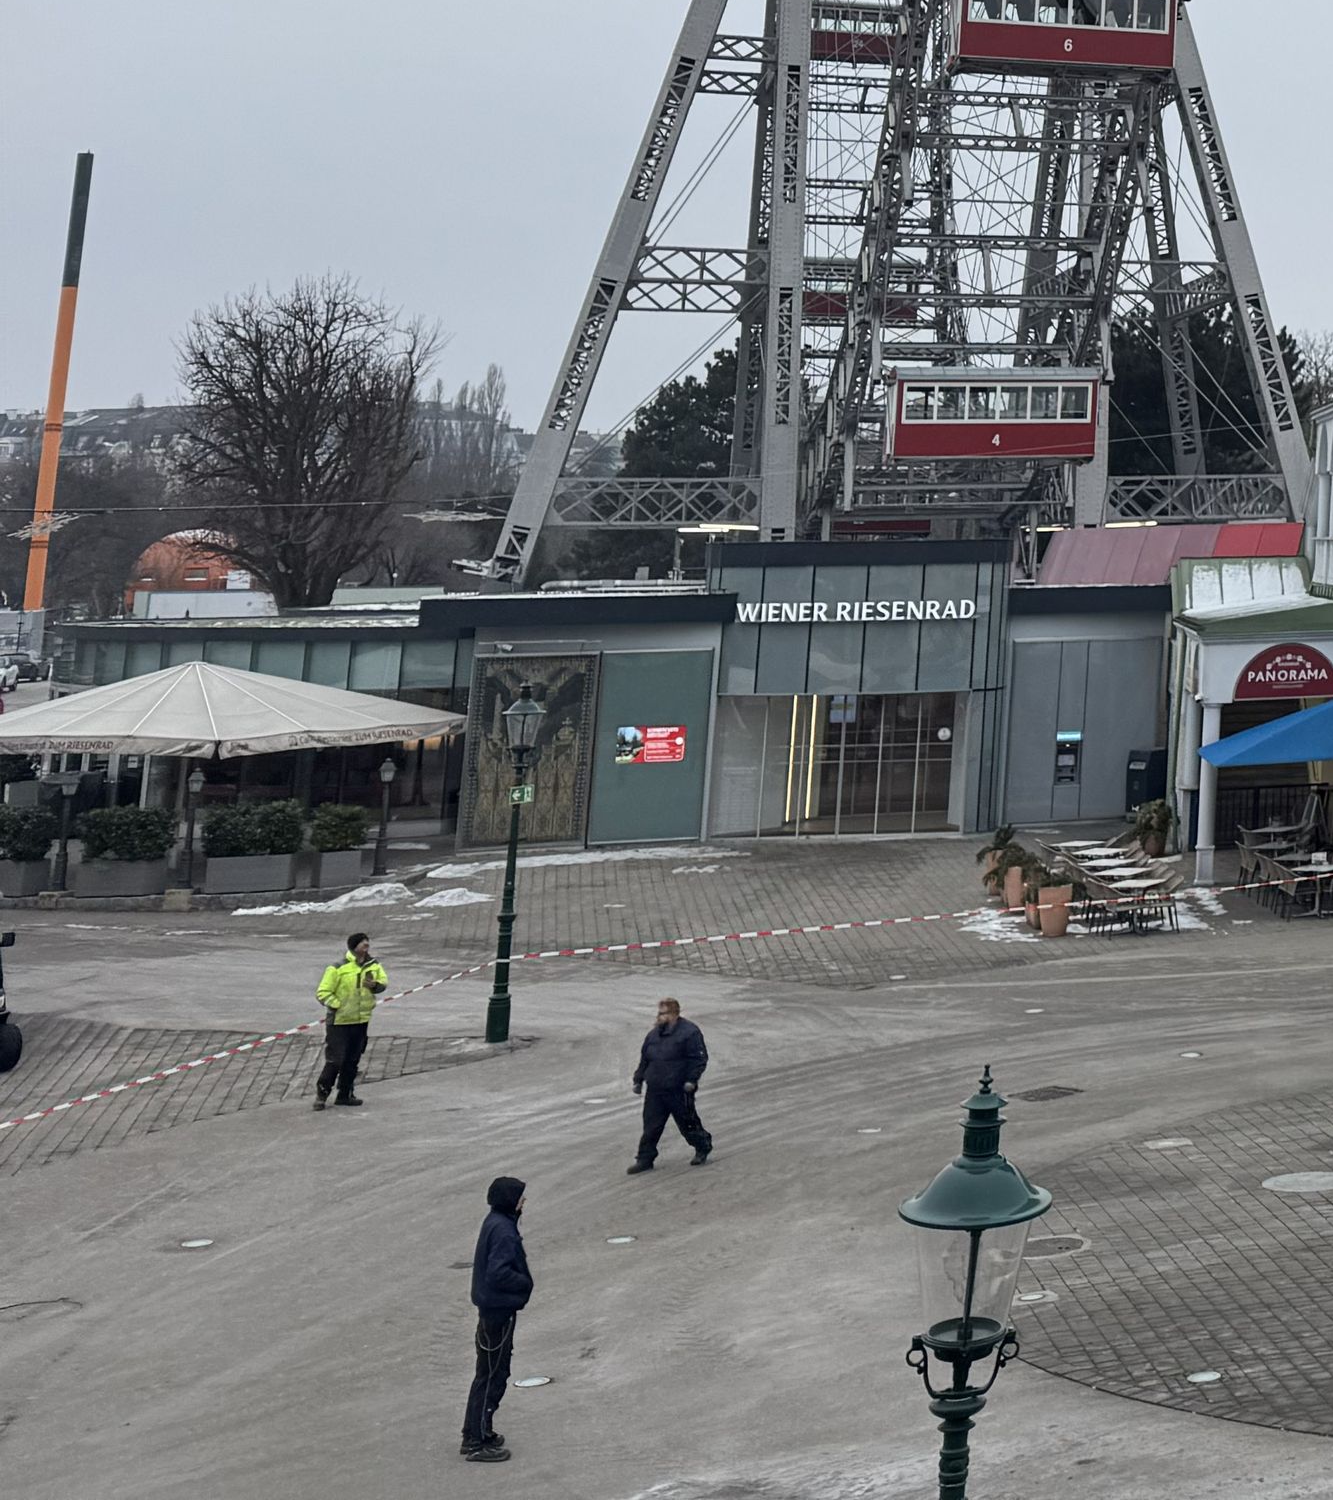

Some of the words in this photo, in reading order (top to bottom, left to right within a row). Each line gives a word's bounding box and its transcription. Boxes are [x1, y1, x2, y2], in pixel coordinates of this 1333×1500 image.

[1064, 39, 1073, 52] 6
[991, 434, 1001, 447] 4
[736, 602, 828, 623] WIENER
[836, 599, 976, 622] RIESENRAD
[1247, 668, 1328, 683] PANORAMA
